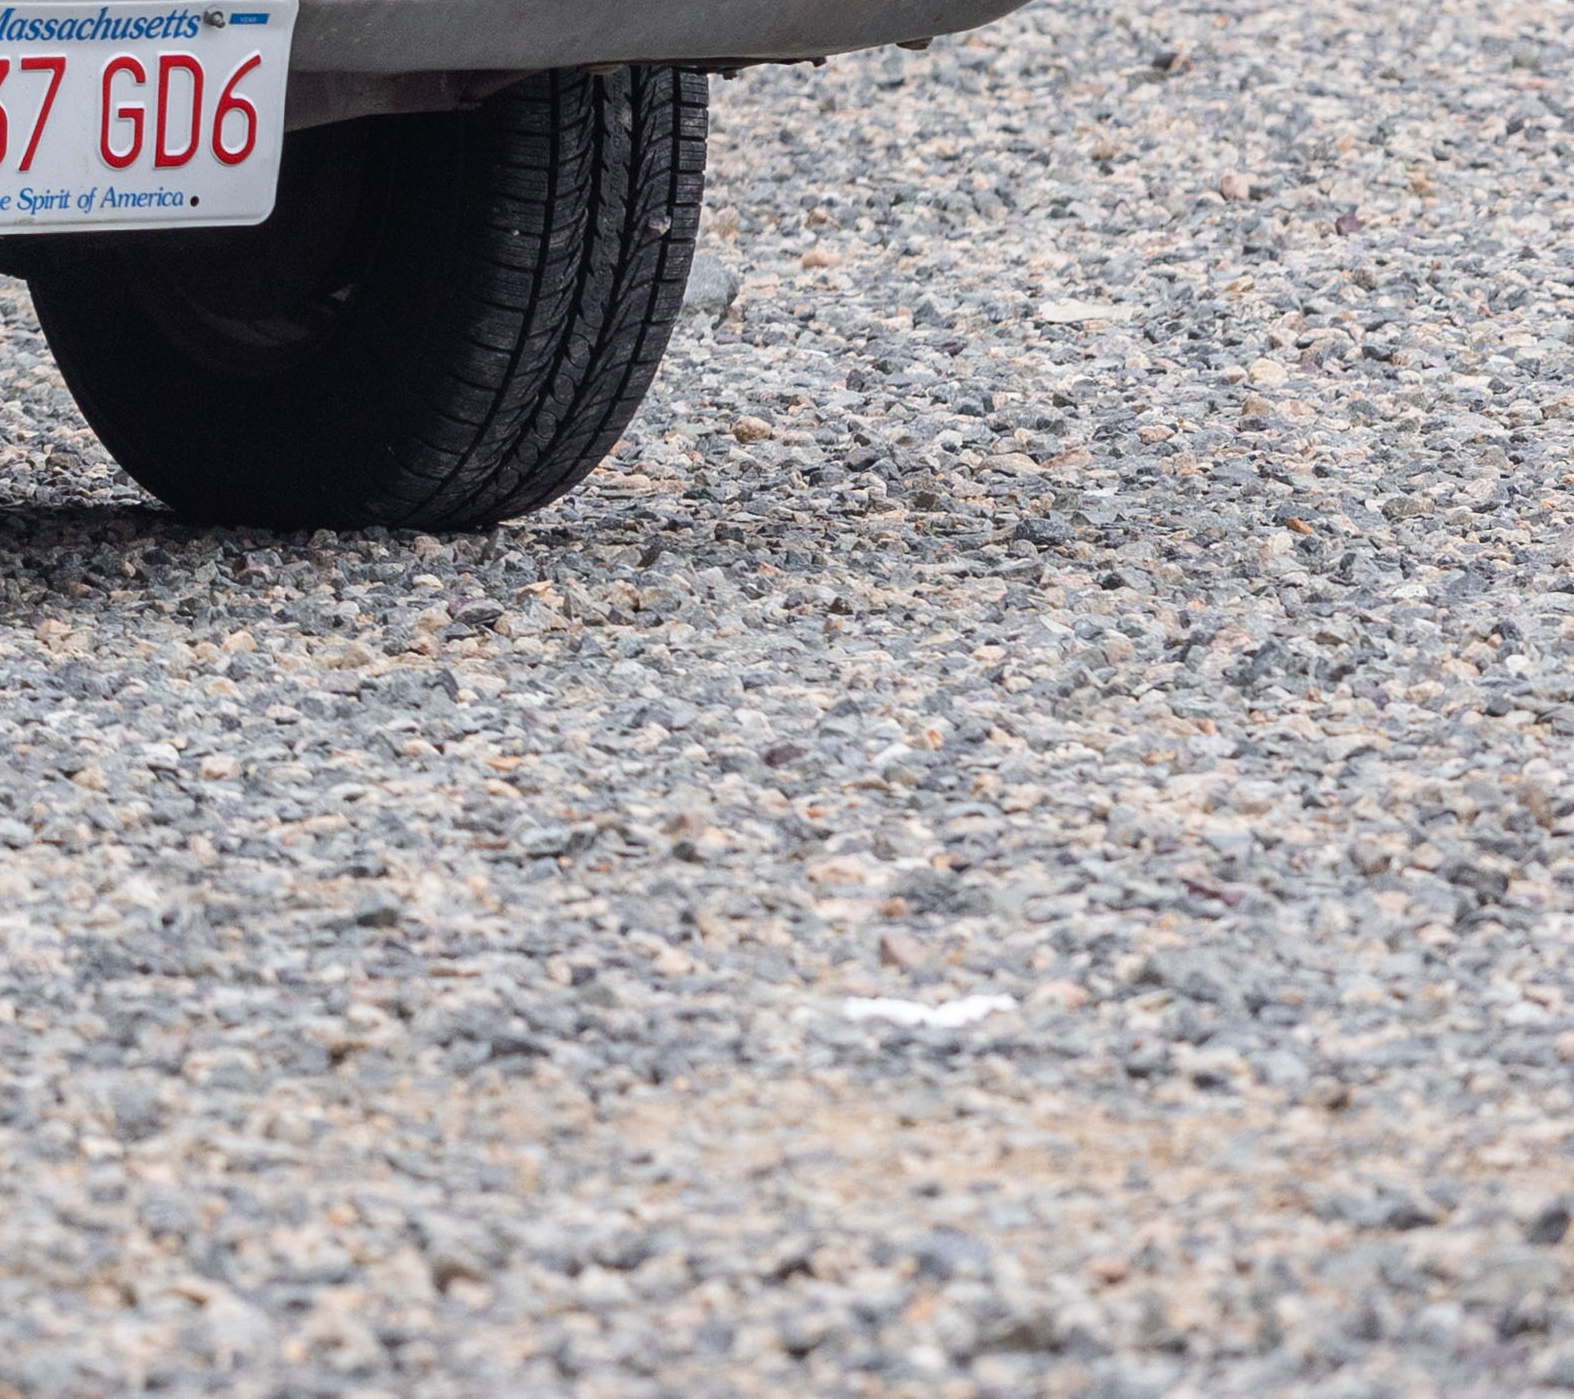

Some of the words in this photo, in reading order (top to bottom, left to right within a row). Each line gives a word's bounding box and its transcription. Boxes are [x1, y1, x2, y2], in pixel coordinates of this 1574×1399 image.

[99, 53, 263, 170] GD6
[16, 187, 70, 216] Spirit
[77, 186, 98, 214] of
[100, 186, 185, 209] America
